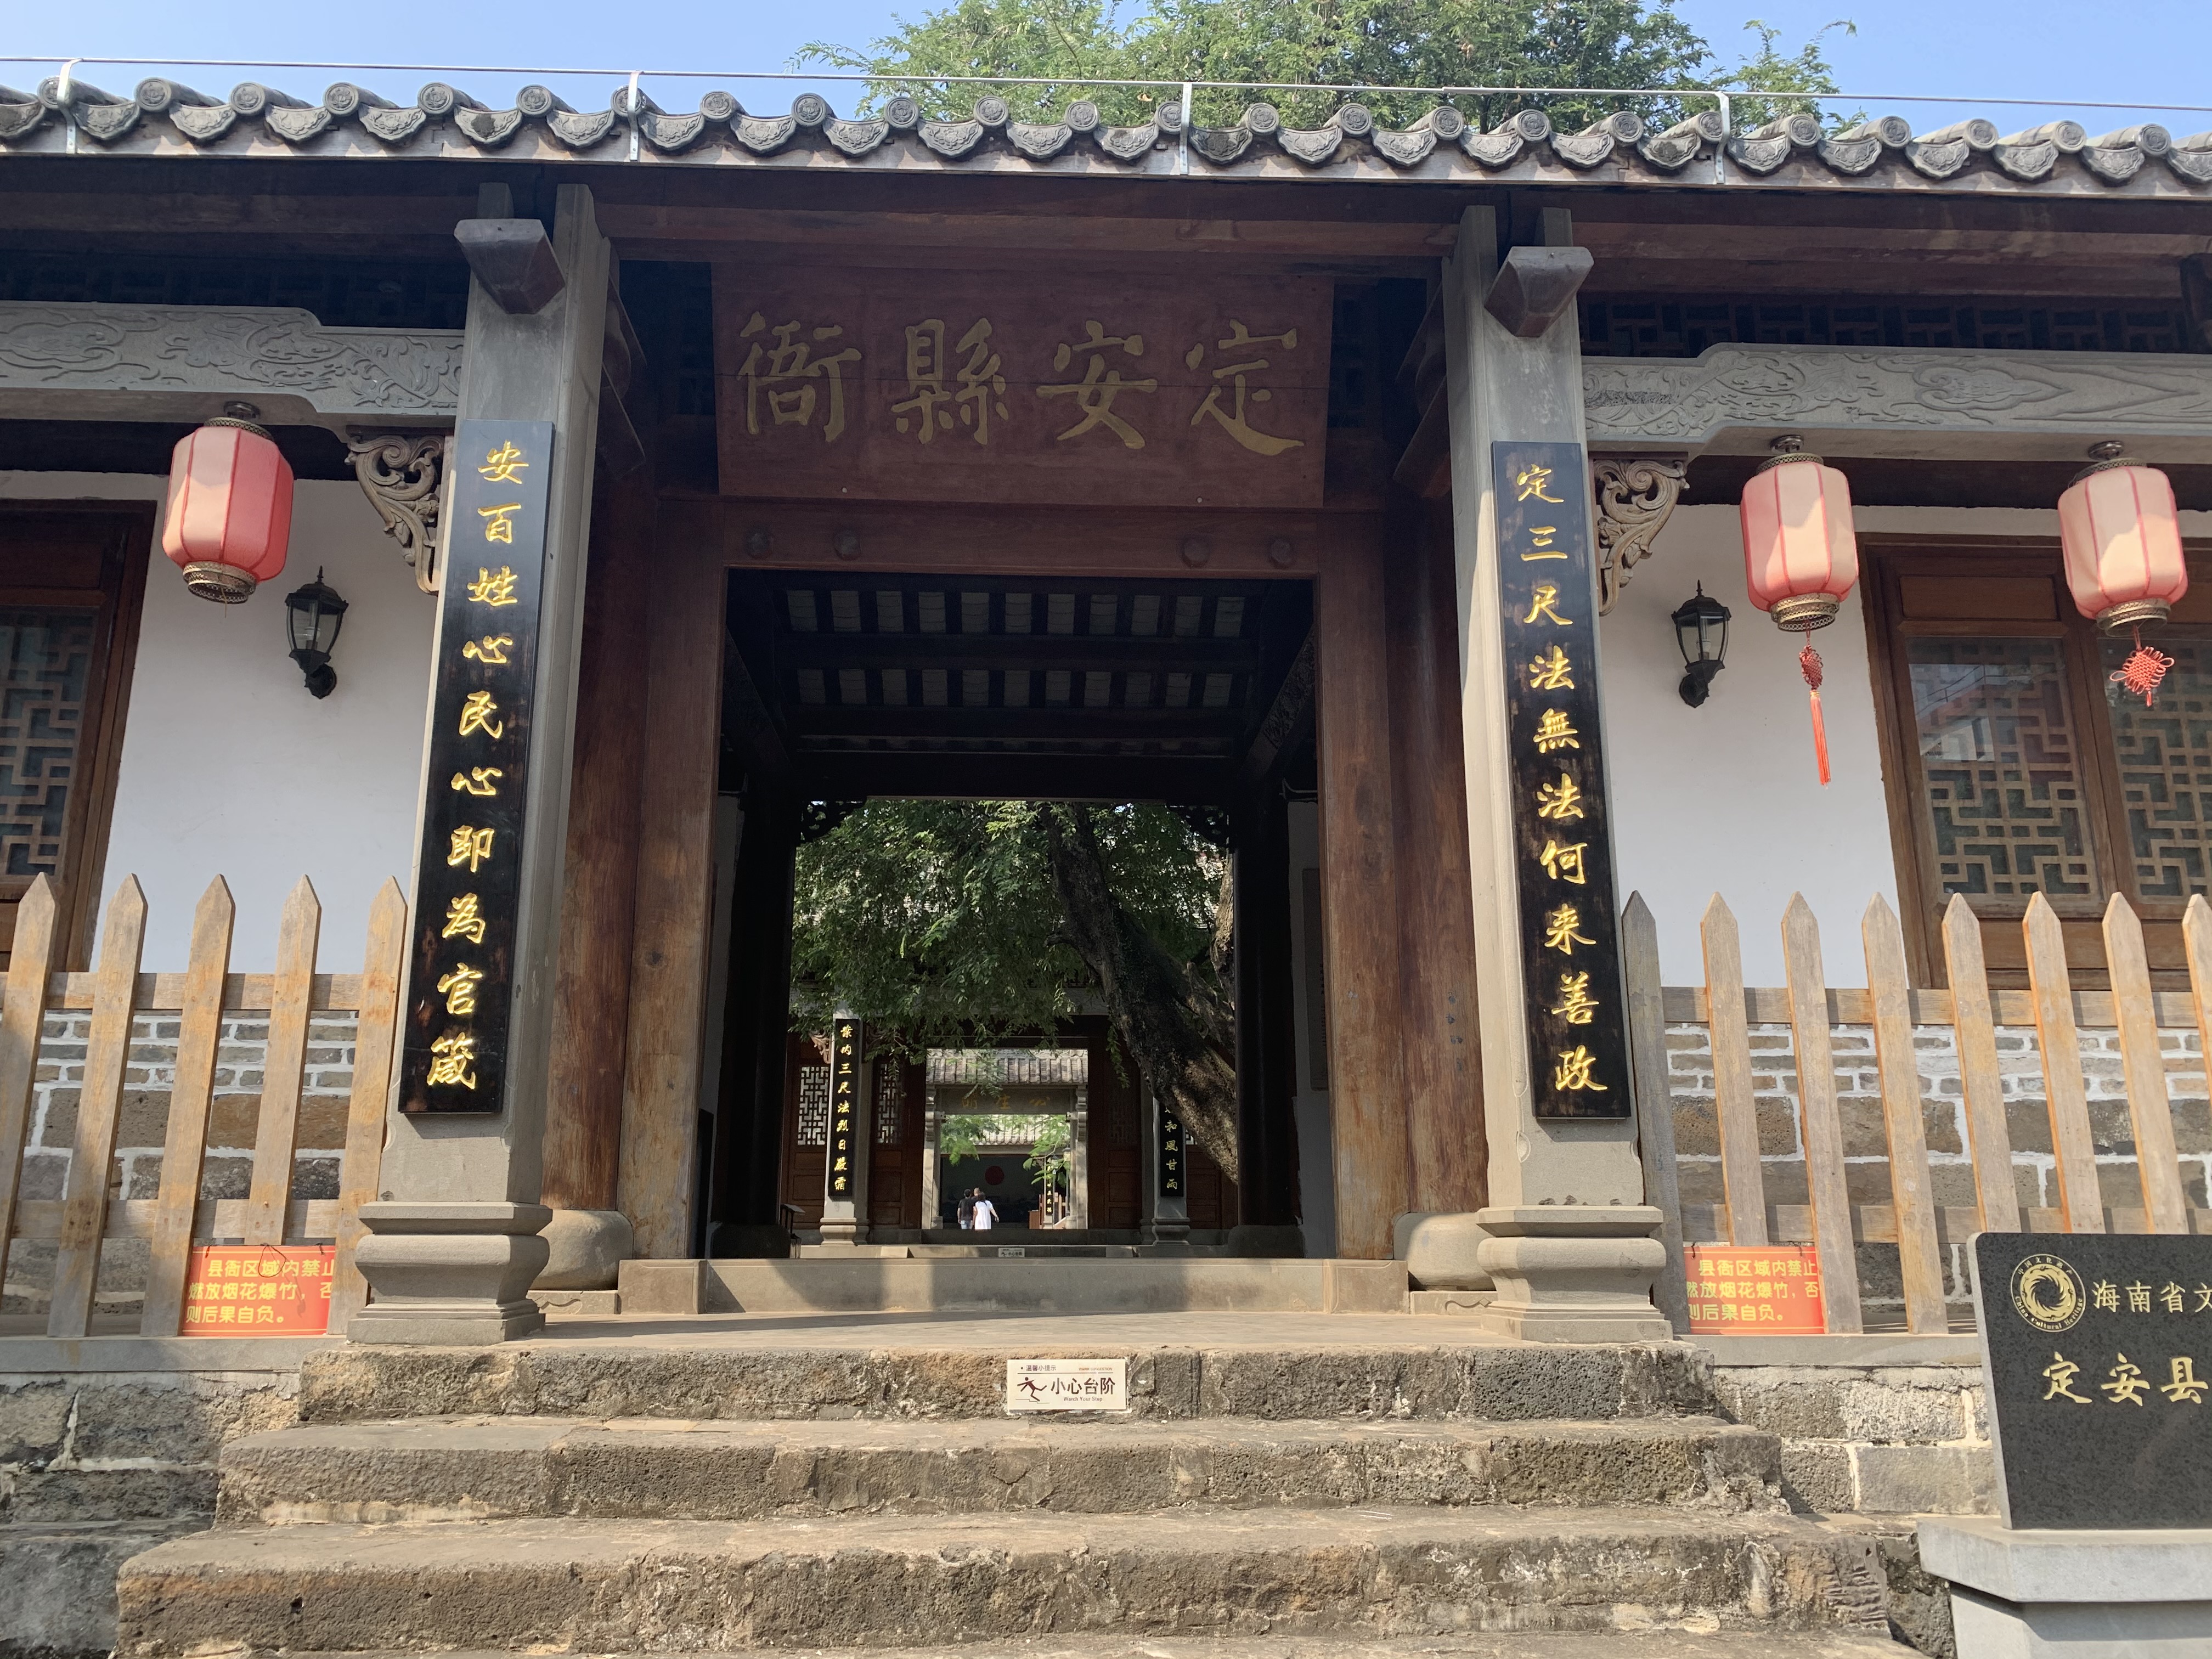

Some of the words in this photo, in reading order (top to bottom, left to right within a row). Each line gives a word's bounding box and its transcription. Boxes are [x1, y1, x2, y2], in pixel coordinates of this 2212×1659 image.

[207, 1259, 334, 1278] 县衙区域内禁止
[1699, 1260, 1818, 1277] 县衙区域内禁止
[1051, 1377, 1115, 1395] 小心台阶
[2042, 1352, 2209, 1406] 定安县
